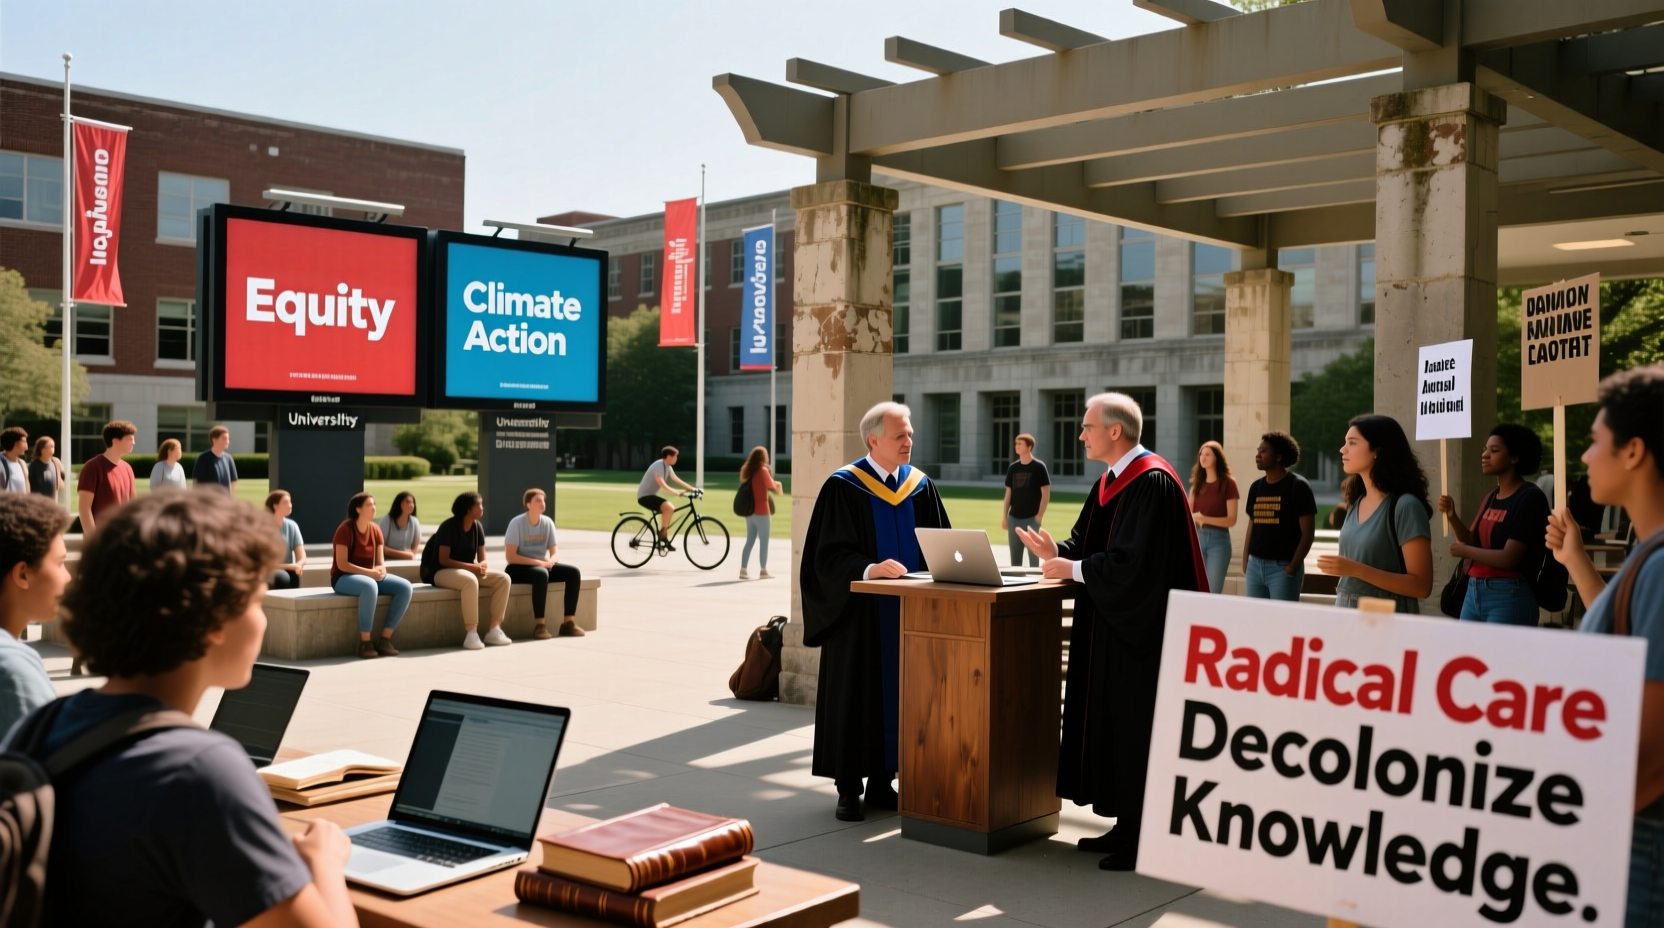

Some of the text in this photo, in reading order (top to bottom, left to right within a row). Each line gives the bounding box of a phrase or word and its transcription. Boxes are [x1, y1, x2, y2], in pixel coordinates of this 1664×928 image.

[246, 276, 396, 342] Equity
[463, 281, 582, 322] Climate
[463, 320, 567, 356] Action
[1184, 624, 1608, 741] Radical Care
[1178, 699, 1584, 827] Decolonize
[1169, 775, 1599, 925] Knowledge.
